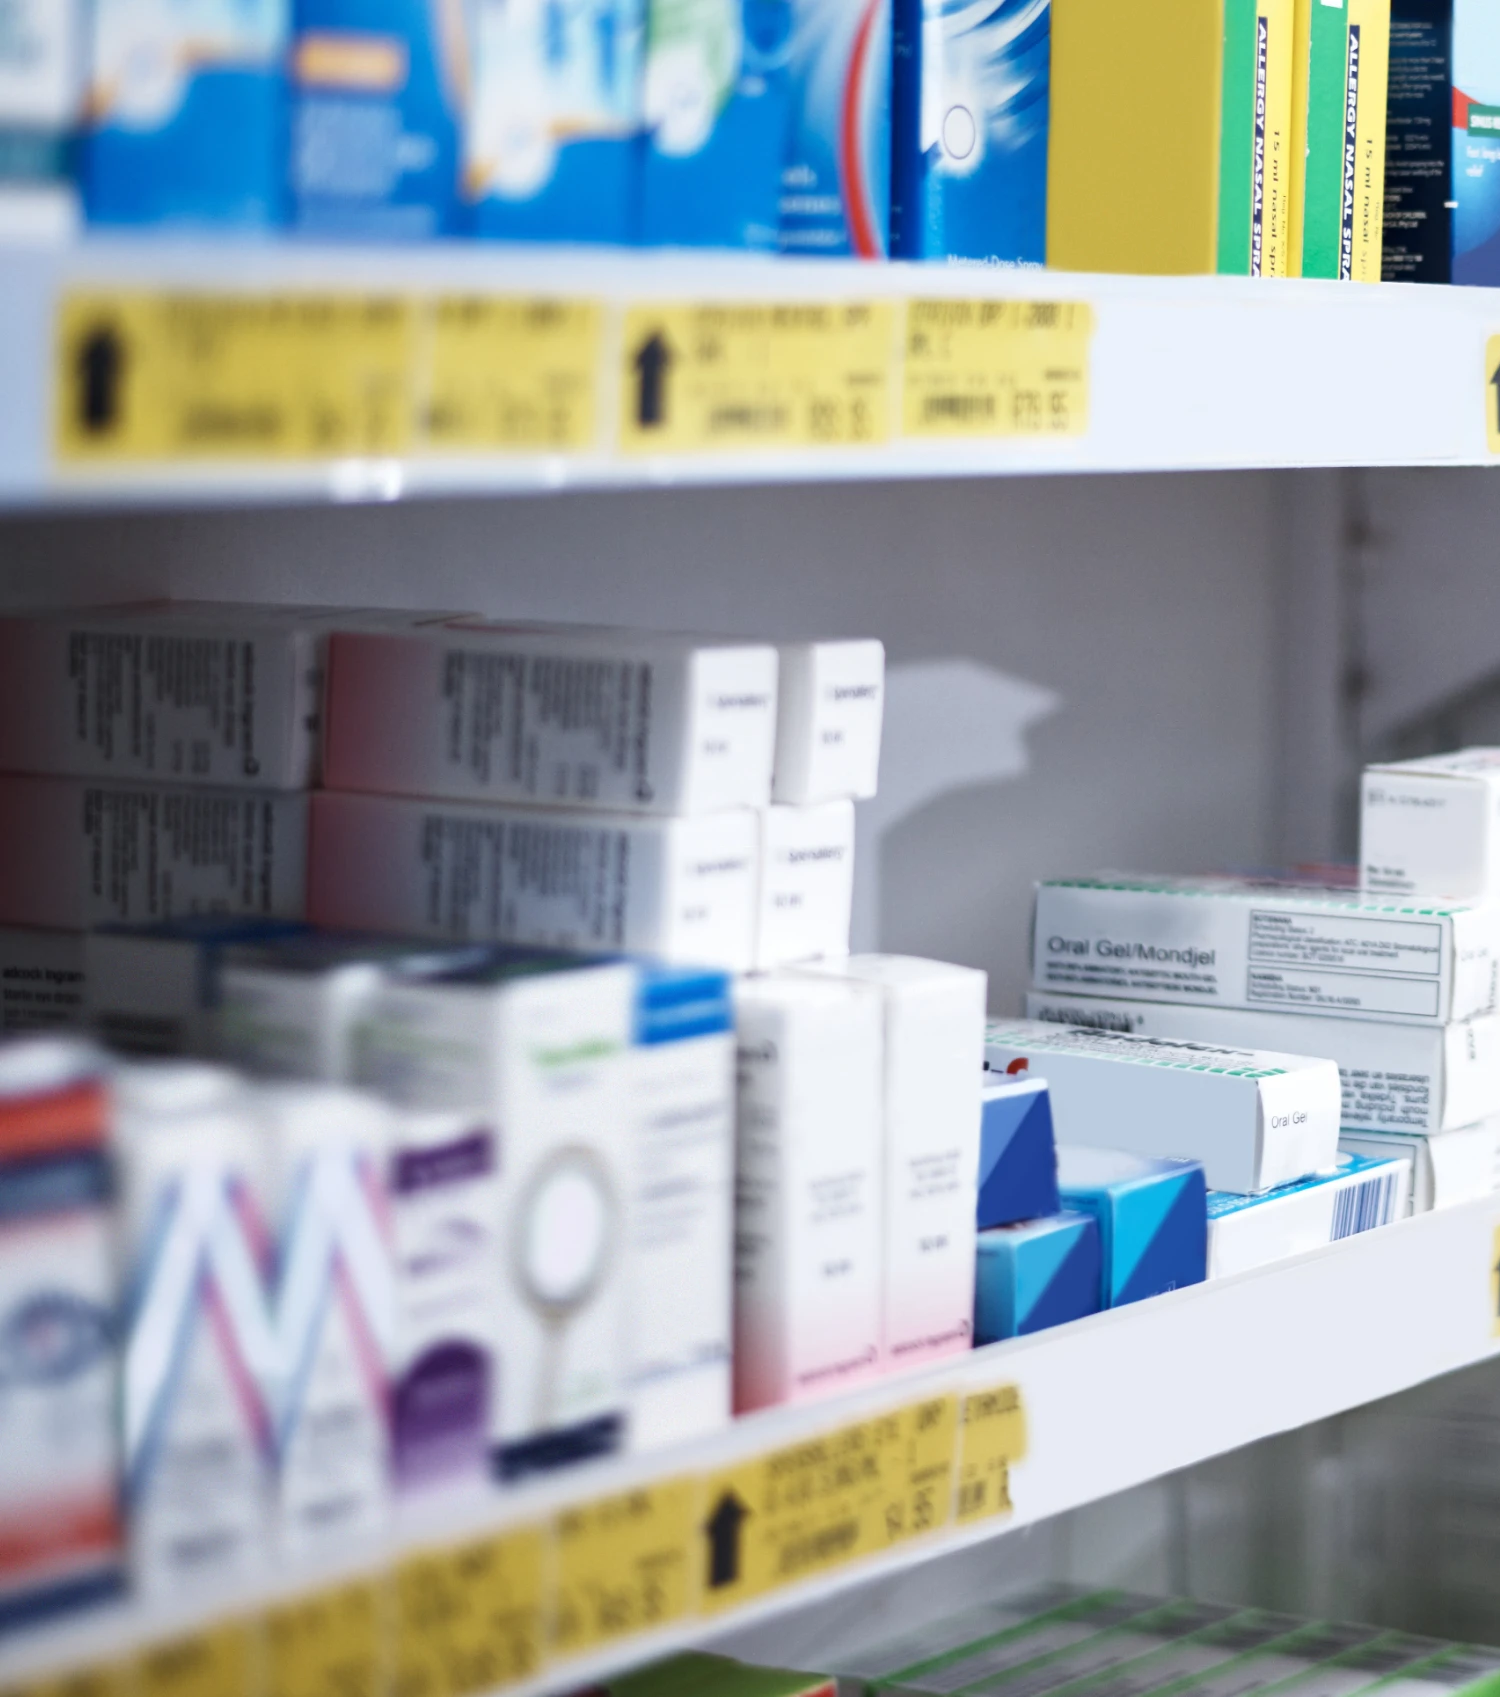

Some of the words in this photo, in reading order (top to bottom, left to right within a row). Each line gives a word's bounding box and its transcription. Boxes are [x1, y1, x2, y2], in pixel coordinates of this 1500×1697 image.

[1255, 22, 1267, 131] ALLERGY
[1346, 33, 1359, 139] ALLERGY
[1273, 131, 1280, 152] 15
[1366, 139, 1373, 159] 15
[1253, 136, 1264, 216] NASAL
[1272, 159, 1279, 182] ml
[1343, 143, 1355, 221] NASAL
[1364, 166, 1371, 189] ml
[1362, 195, 1370, 243] nasal
[1251, 222, 1262, 278] SPRA
[1268, 245, 1277, 278] spr
[1341, 227, 1352, 281] SPRA
[1047, 935, 1090, 956] Oral
[1096, 938, 1217, 969] Gel/Mondjel
[1271, 1113, 1290, 1129] Oral
[1292, 1110, 1308, 1125] Gel
